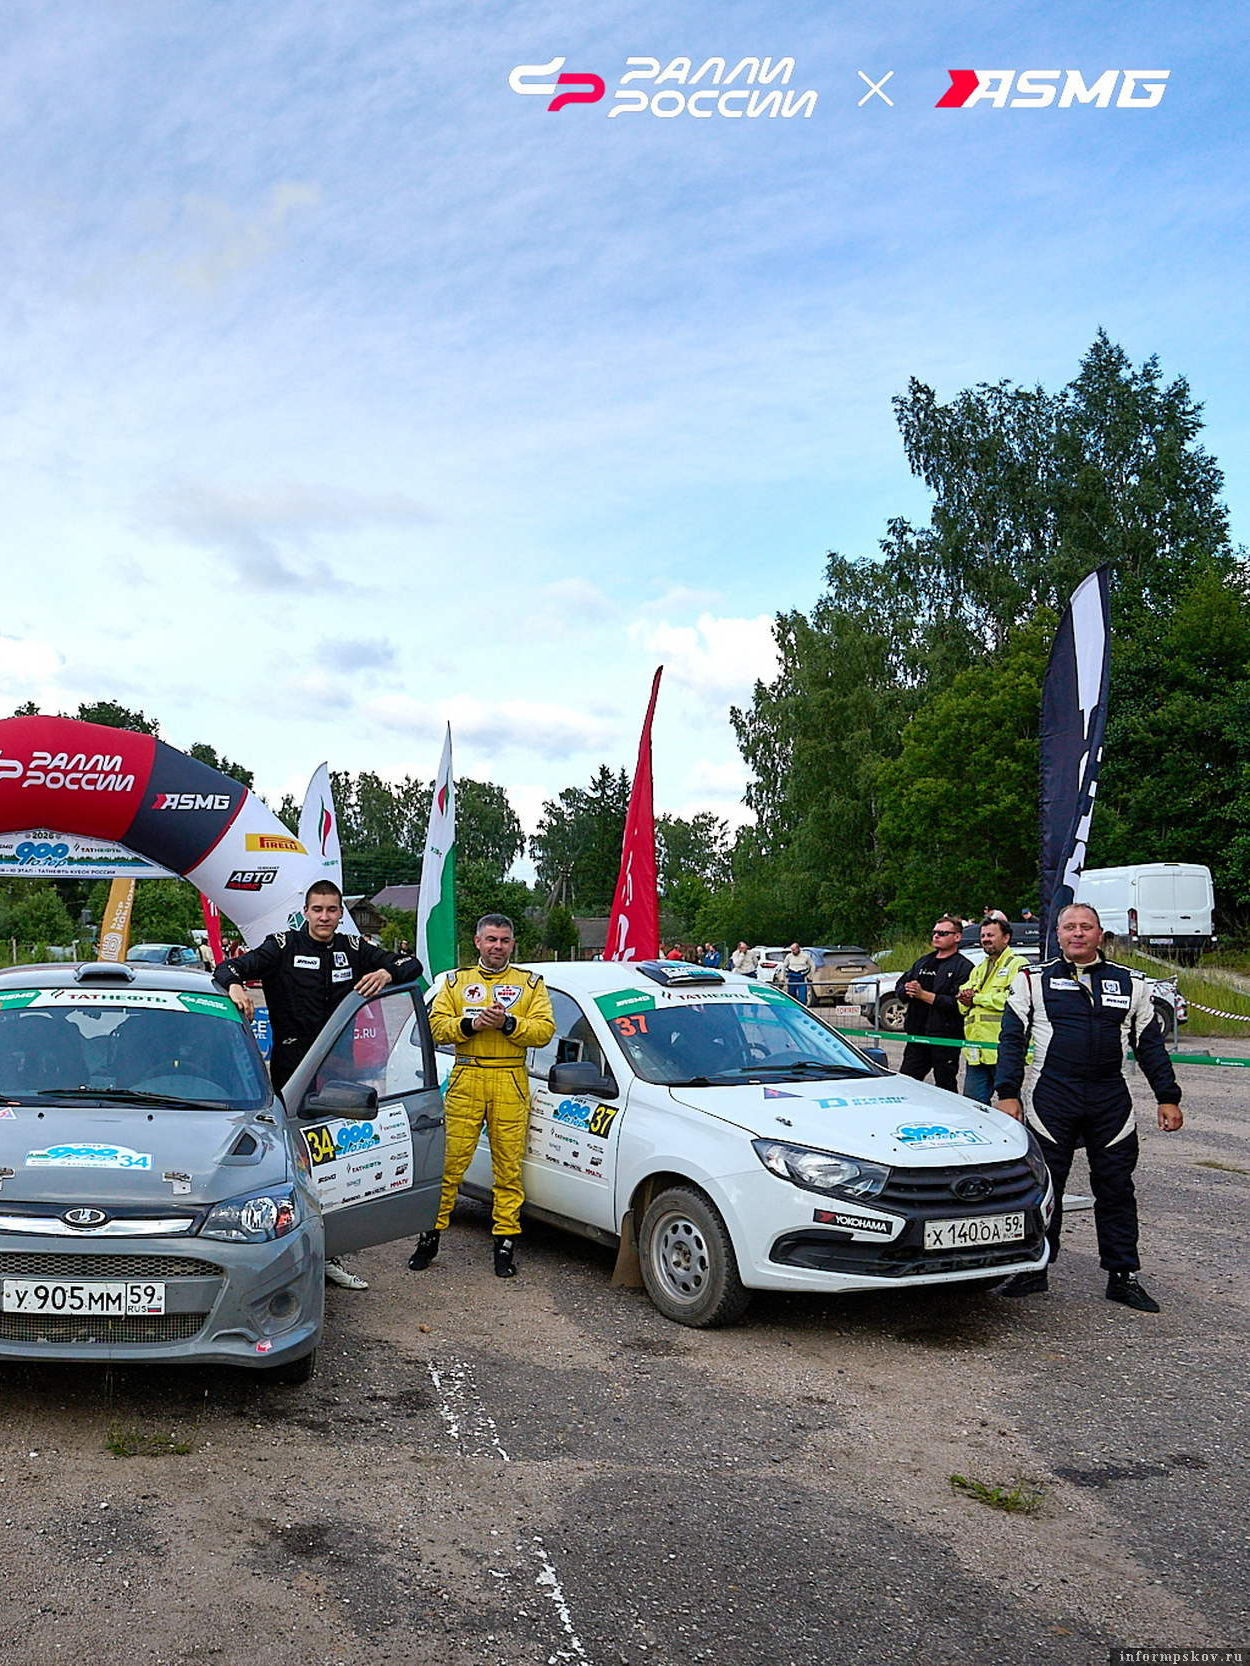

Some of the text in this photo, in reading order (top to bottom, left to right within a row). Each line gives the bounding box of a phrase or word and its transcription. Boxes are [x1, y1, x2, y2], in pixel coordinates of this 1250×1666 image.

[29, 752, 122, 771] РАЛЛИ
[22, 771, 135, 791] РОССИИ
[161, 794, 230, 809] ASMG
[15, 842, 69, 864] 900
[259, 837, 299, 850] PIRELLI
[231, 872, 275, 883] АВТО
[677, 992, 749, 1000] ТАТНЕФТЬ
[614, 1015, 648, 1037] 37
[558, 1100, 591, 1120] 900
[591, 1106, 617, 1134] 37
[307, 1128, 334, 1162] 34
[337, 1122, 373, 1153] 900
[47, 1147, 118, 1159] 900
[120, 1155, 149, 1168] 34
[835, 1216, 887, 1232] YOKOHAMA
[1005, 1216, 1020, 1232] 59
[130, 1285, 156, 1304] 59
